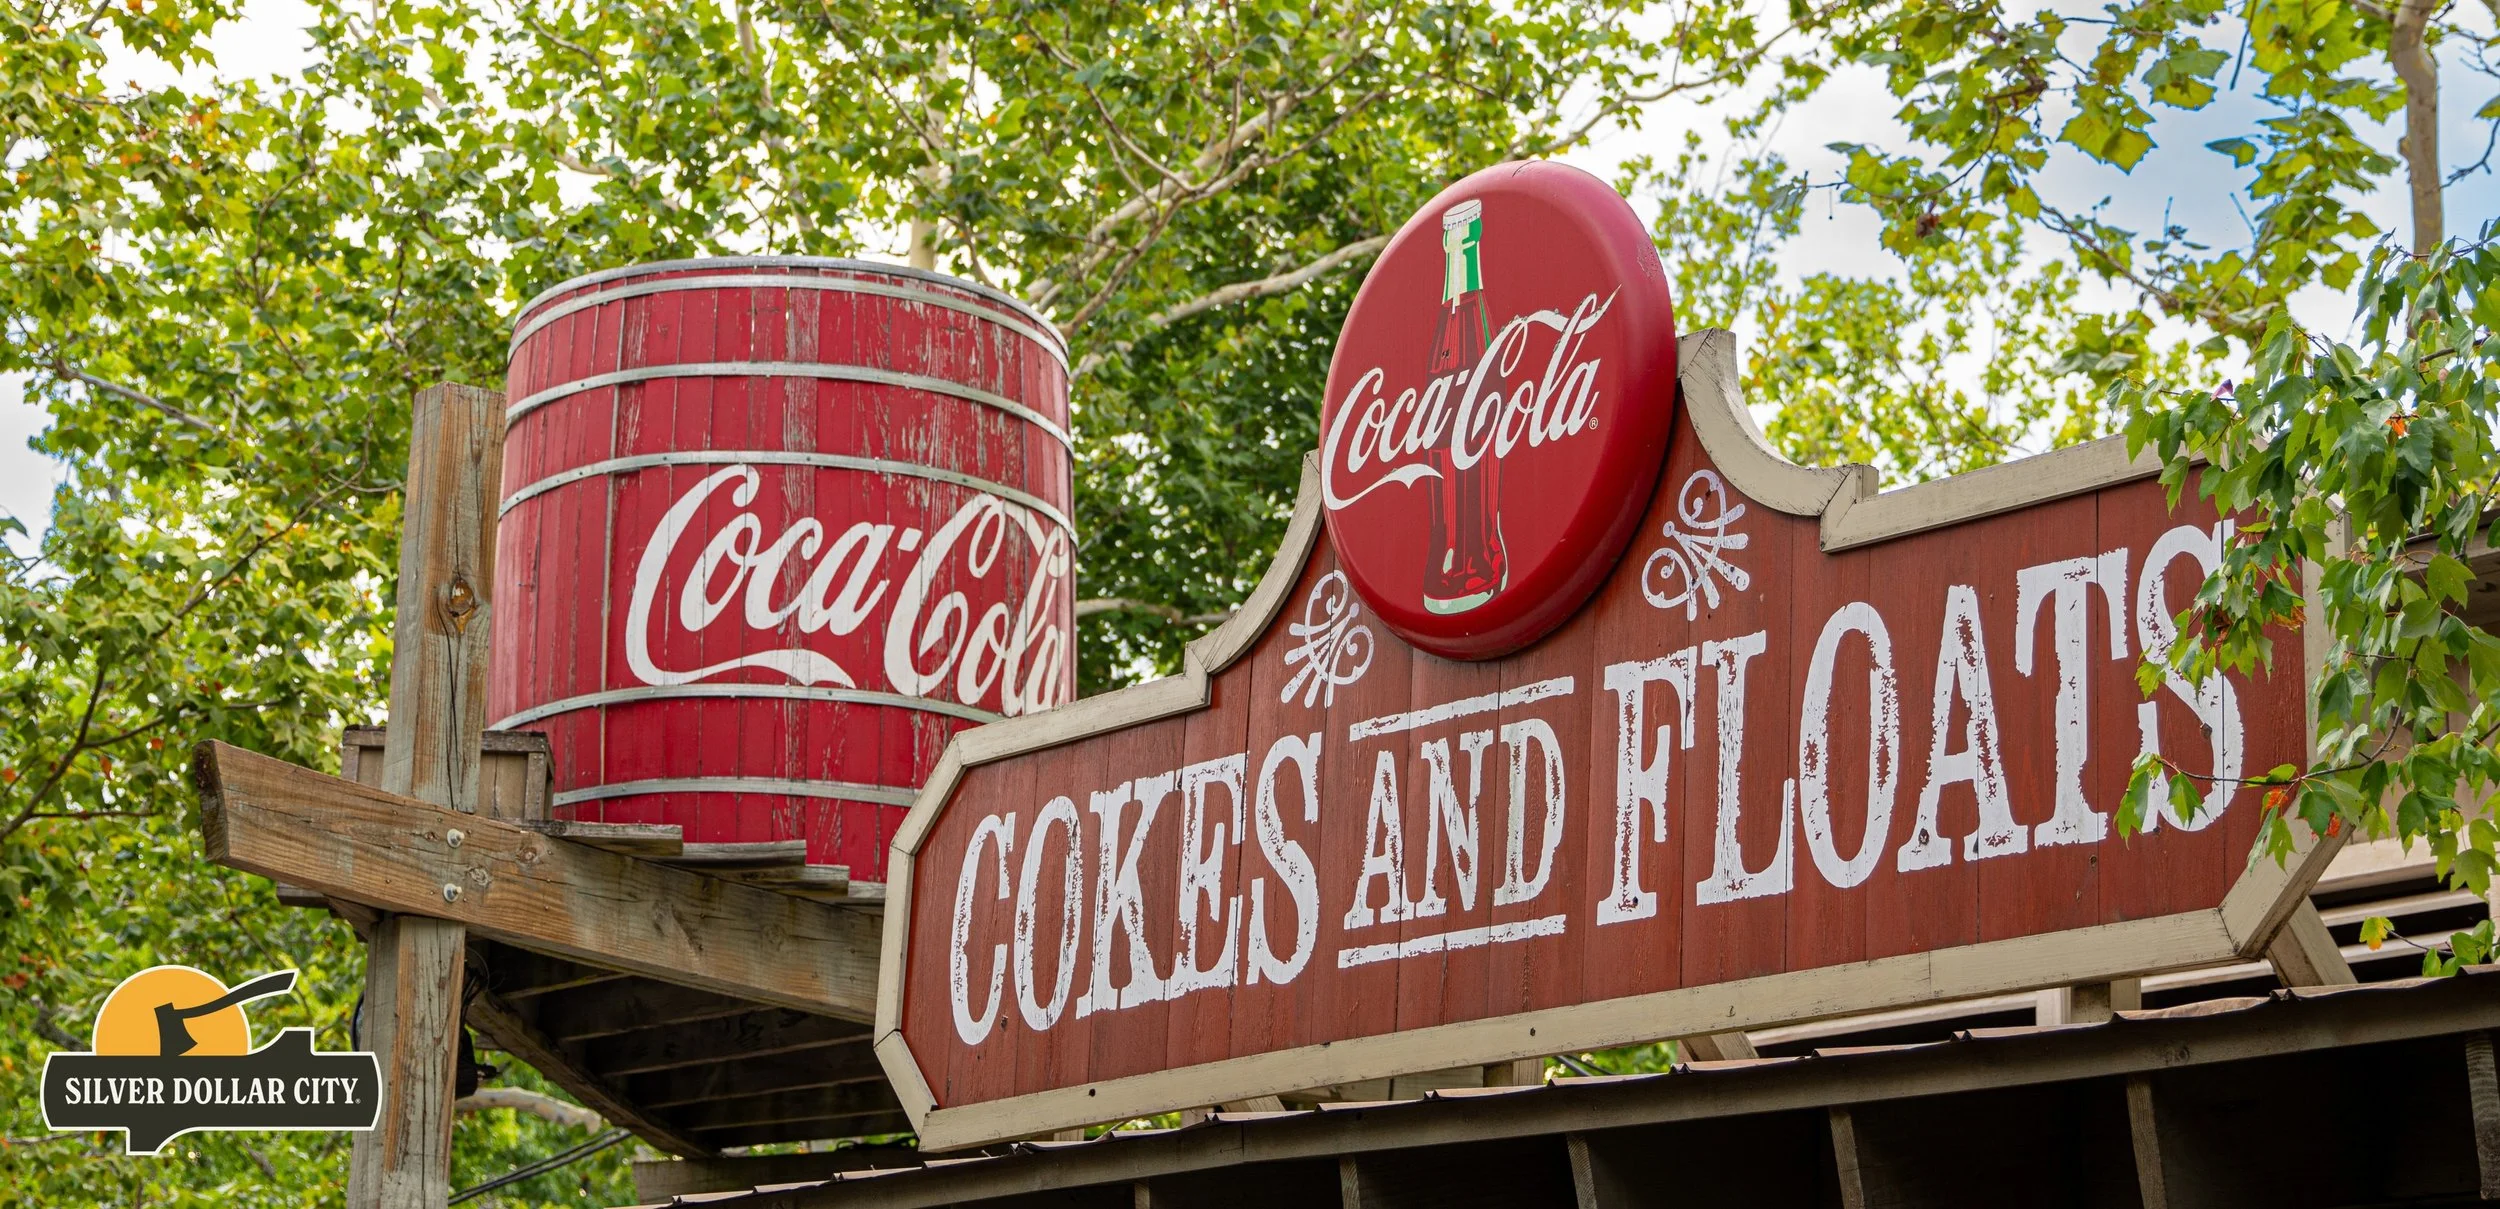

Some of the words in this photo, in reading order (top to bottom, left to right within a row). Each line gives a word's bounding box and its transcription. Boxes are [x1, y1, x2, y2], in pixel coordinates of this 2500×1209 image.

[1322, 284, 1622, 511] Coca-Cola
[625, 464, 1070, 717] Coca-Cola
[950, 731, 1322, 1046] COKES
[1344, 718, 1566, 930] AND
[1597, 519, 2244, 926] FLOATS
